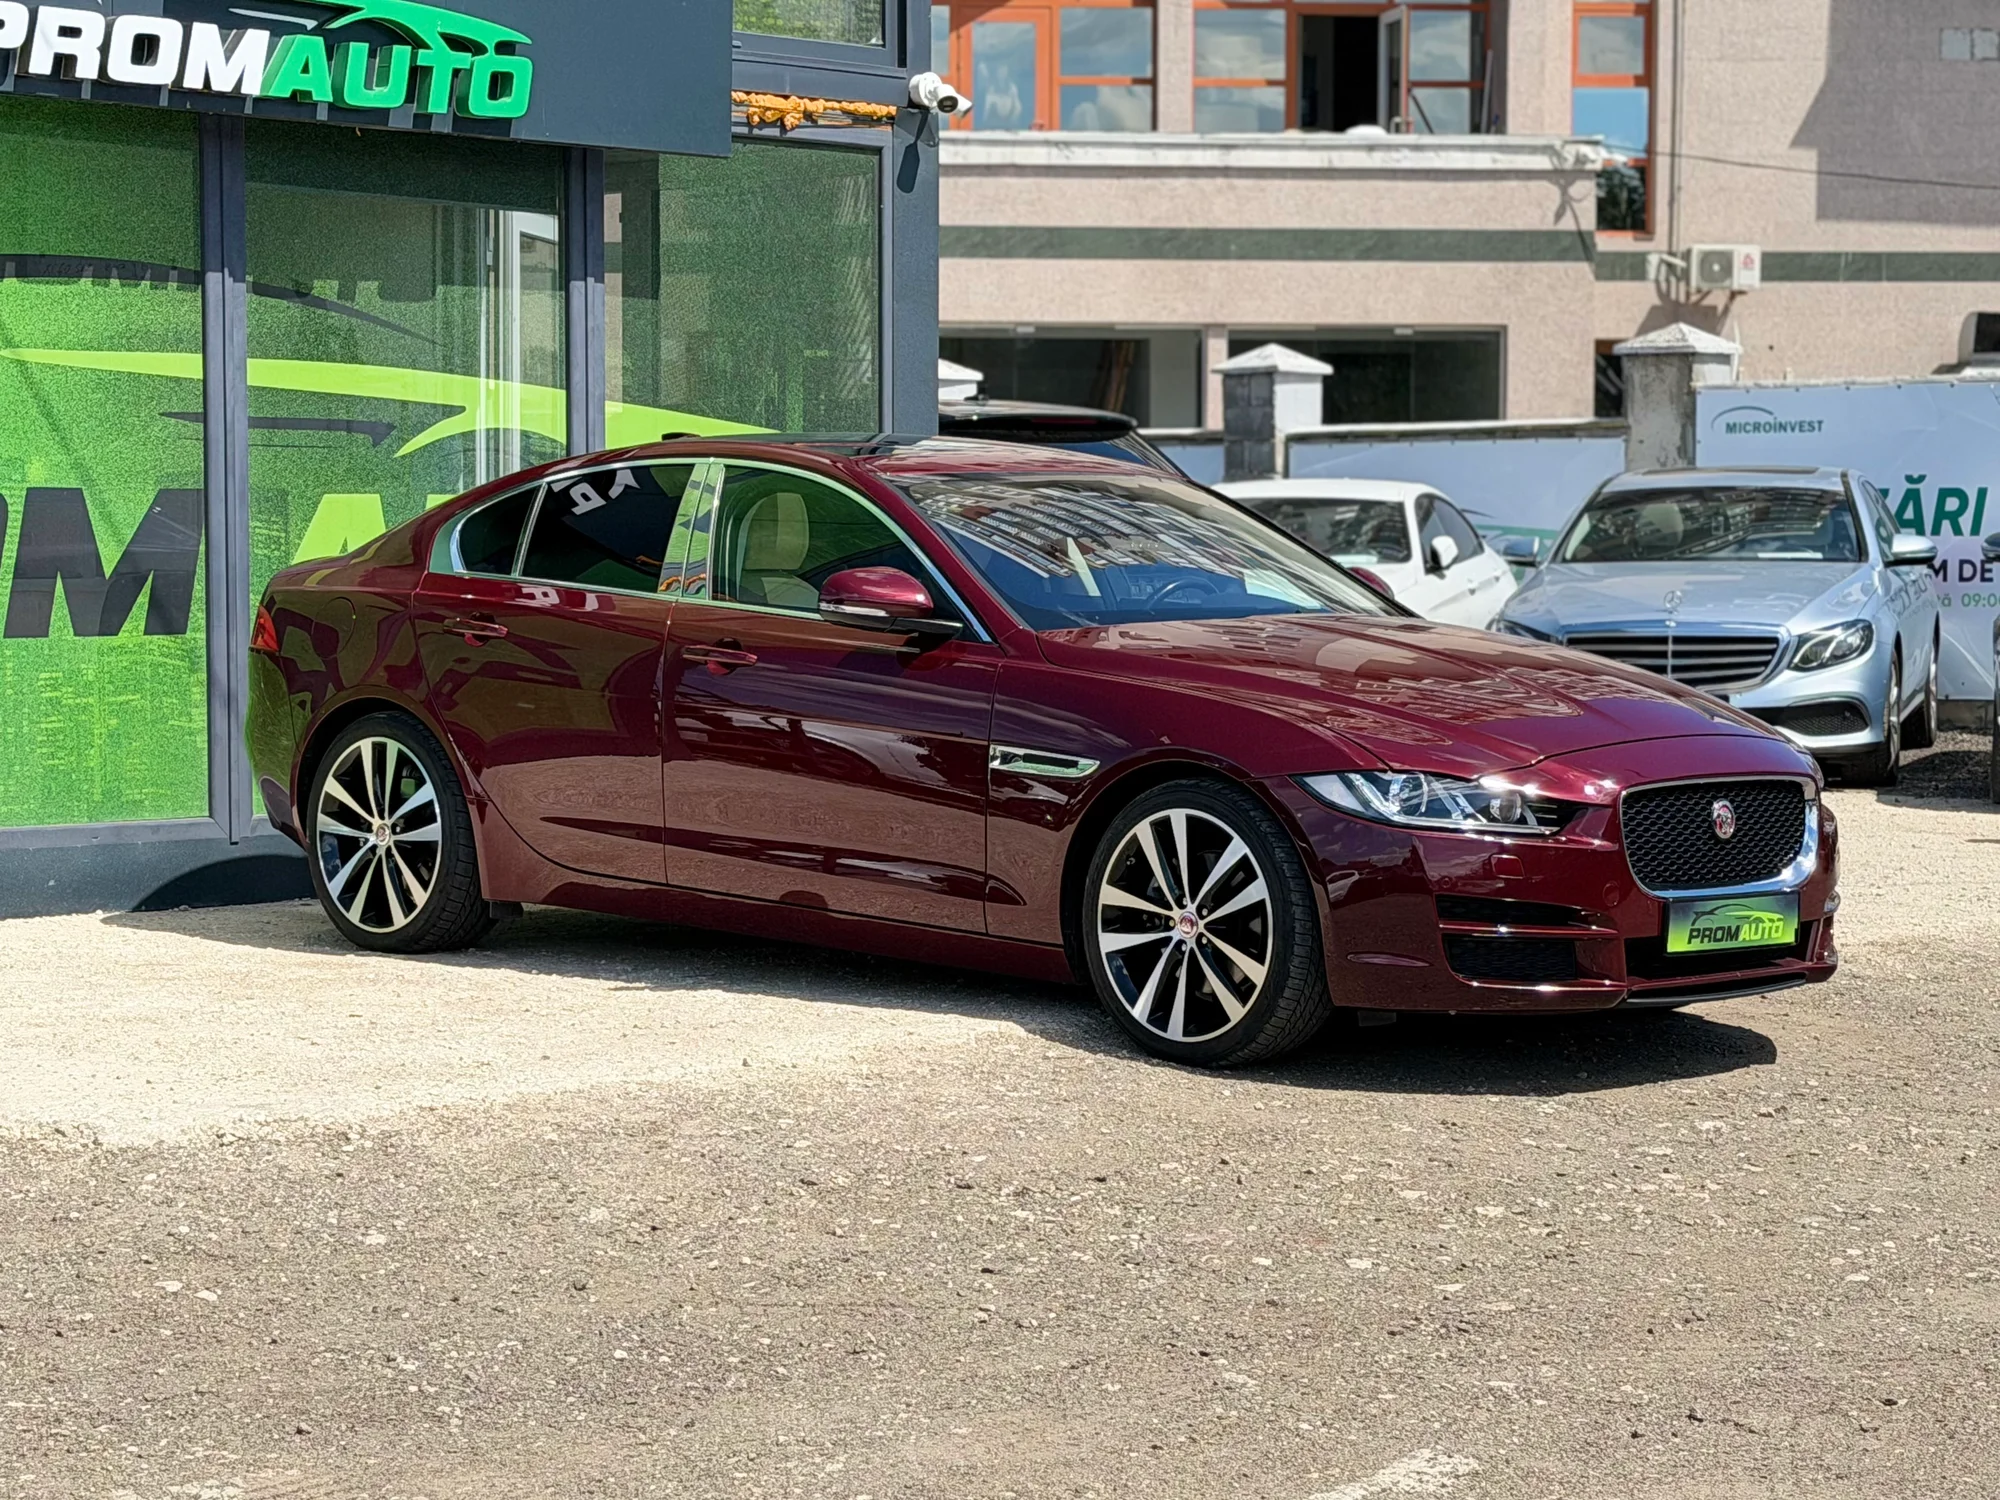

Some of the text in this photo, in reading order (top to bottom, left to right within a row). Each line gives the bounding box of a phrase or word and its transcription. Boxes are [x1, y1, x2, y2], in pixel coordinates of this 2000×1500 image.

[1878, 474, 1988, 537] ĂRI
[1958, 558, 1994, 583] DE
[1961, 592, 2000, 608] 09:0
[1687, 921, 1784, 945] PROMAUTO
